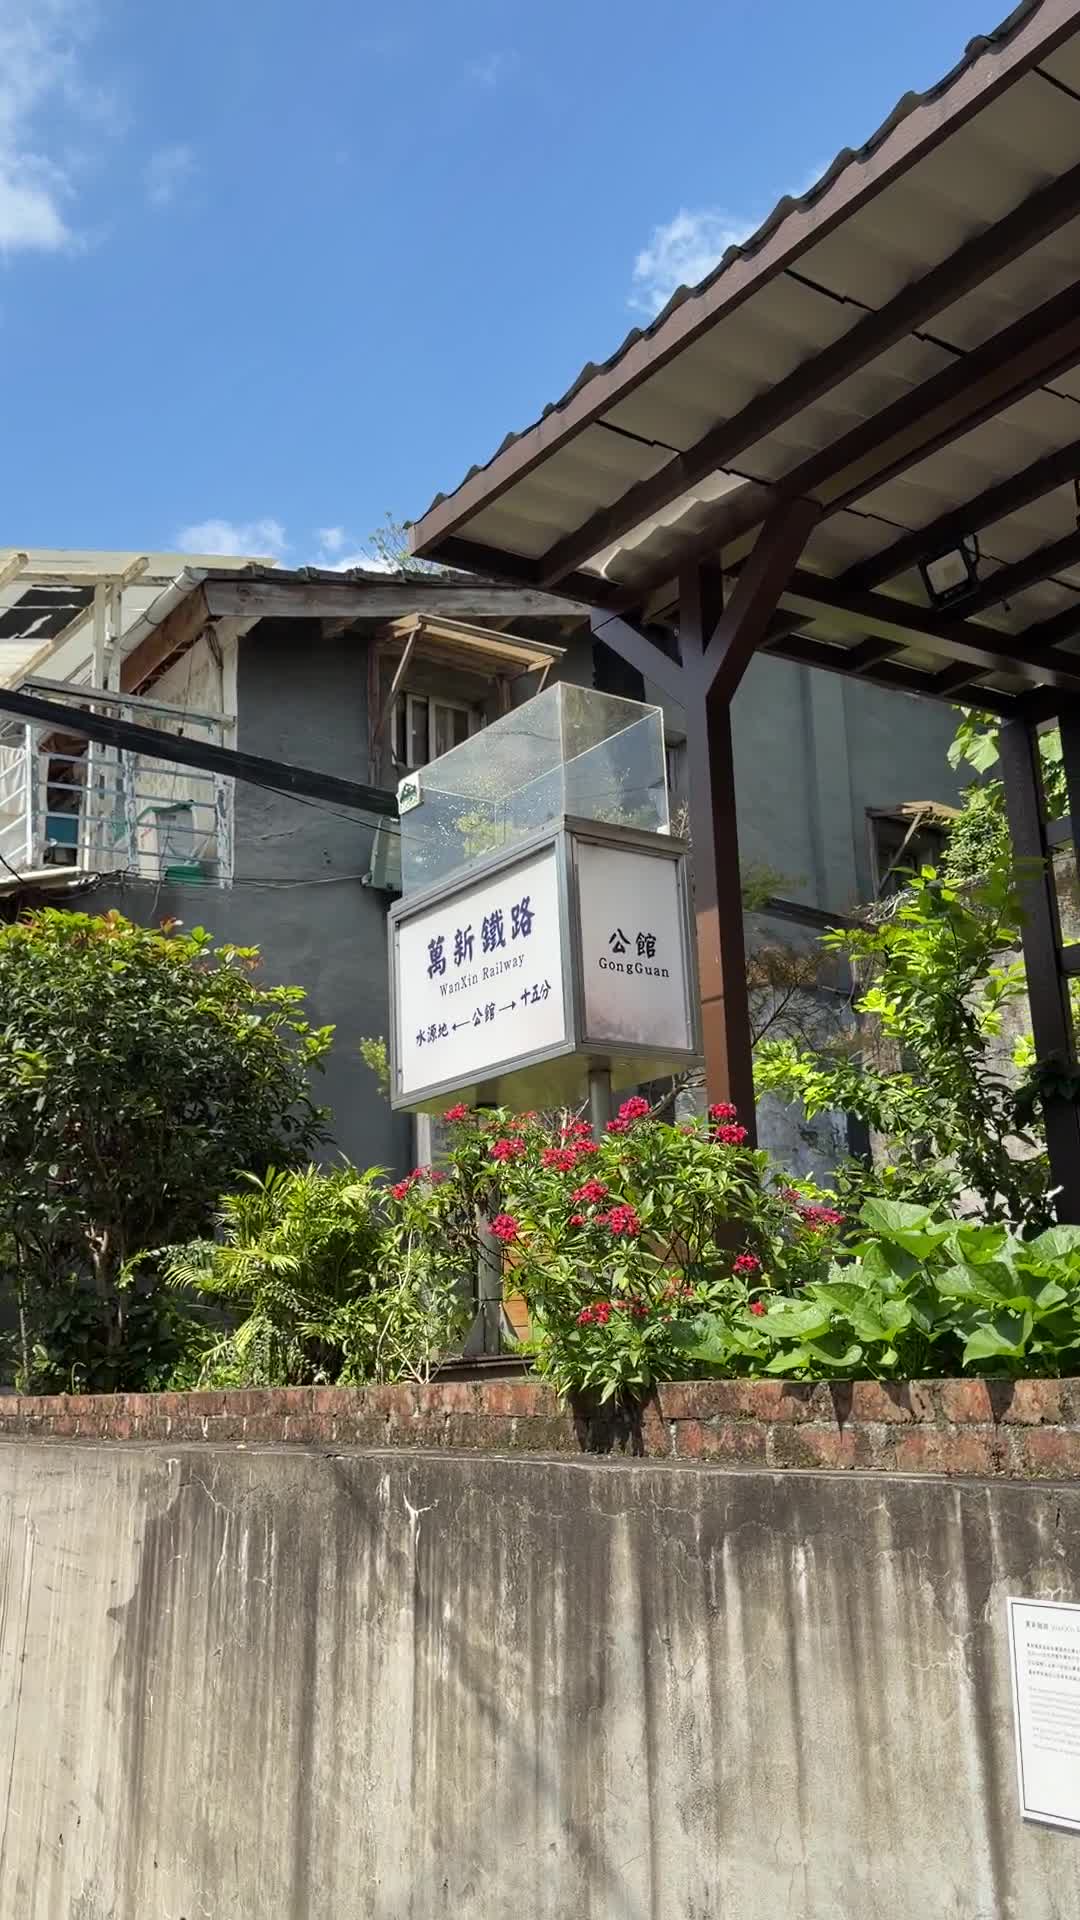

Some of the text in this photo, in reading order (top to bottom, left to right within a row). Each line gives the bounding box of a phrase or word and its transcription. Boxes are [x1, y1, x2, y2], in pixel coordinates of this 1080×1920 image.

[427, 896, 535, 979] 萬新鐵路
[609, 928, 657, 959] 公館
[439, 953, 525, 997] WanXin Railway
[598, 957, 670, 978] GongGuan
[415, 980, 552, 1047] 水源地 公館 十五分
